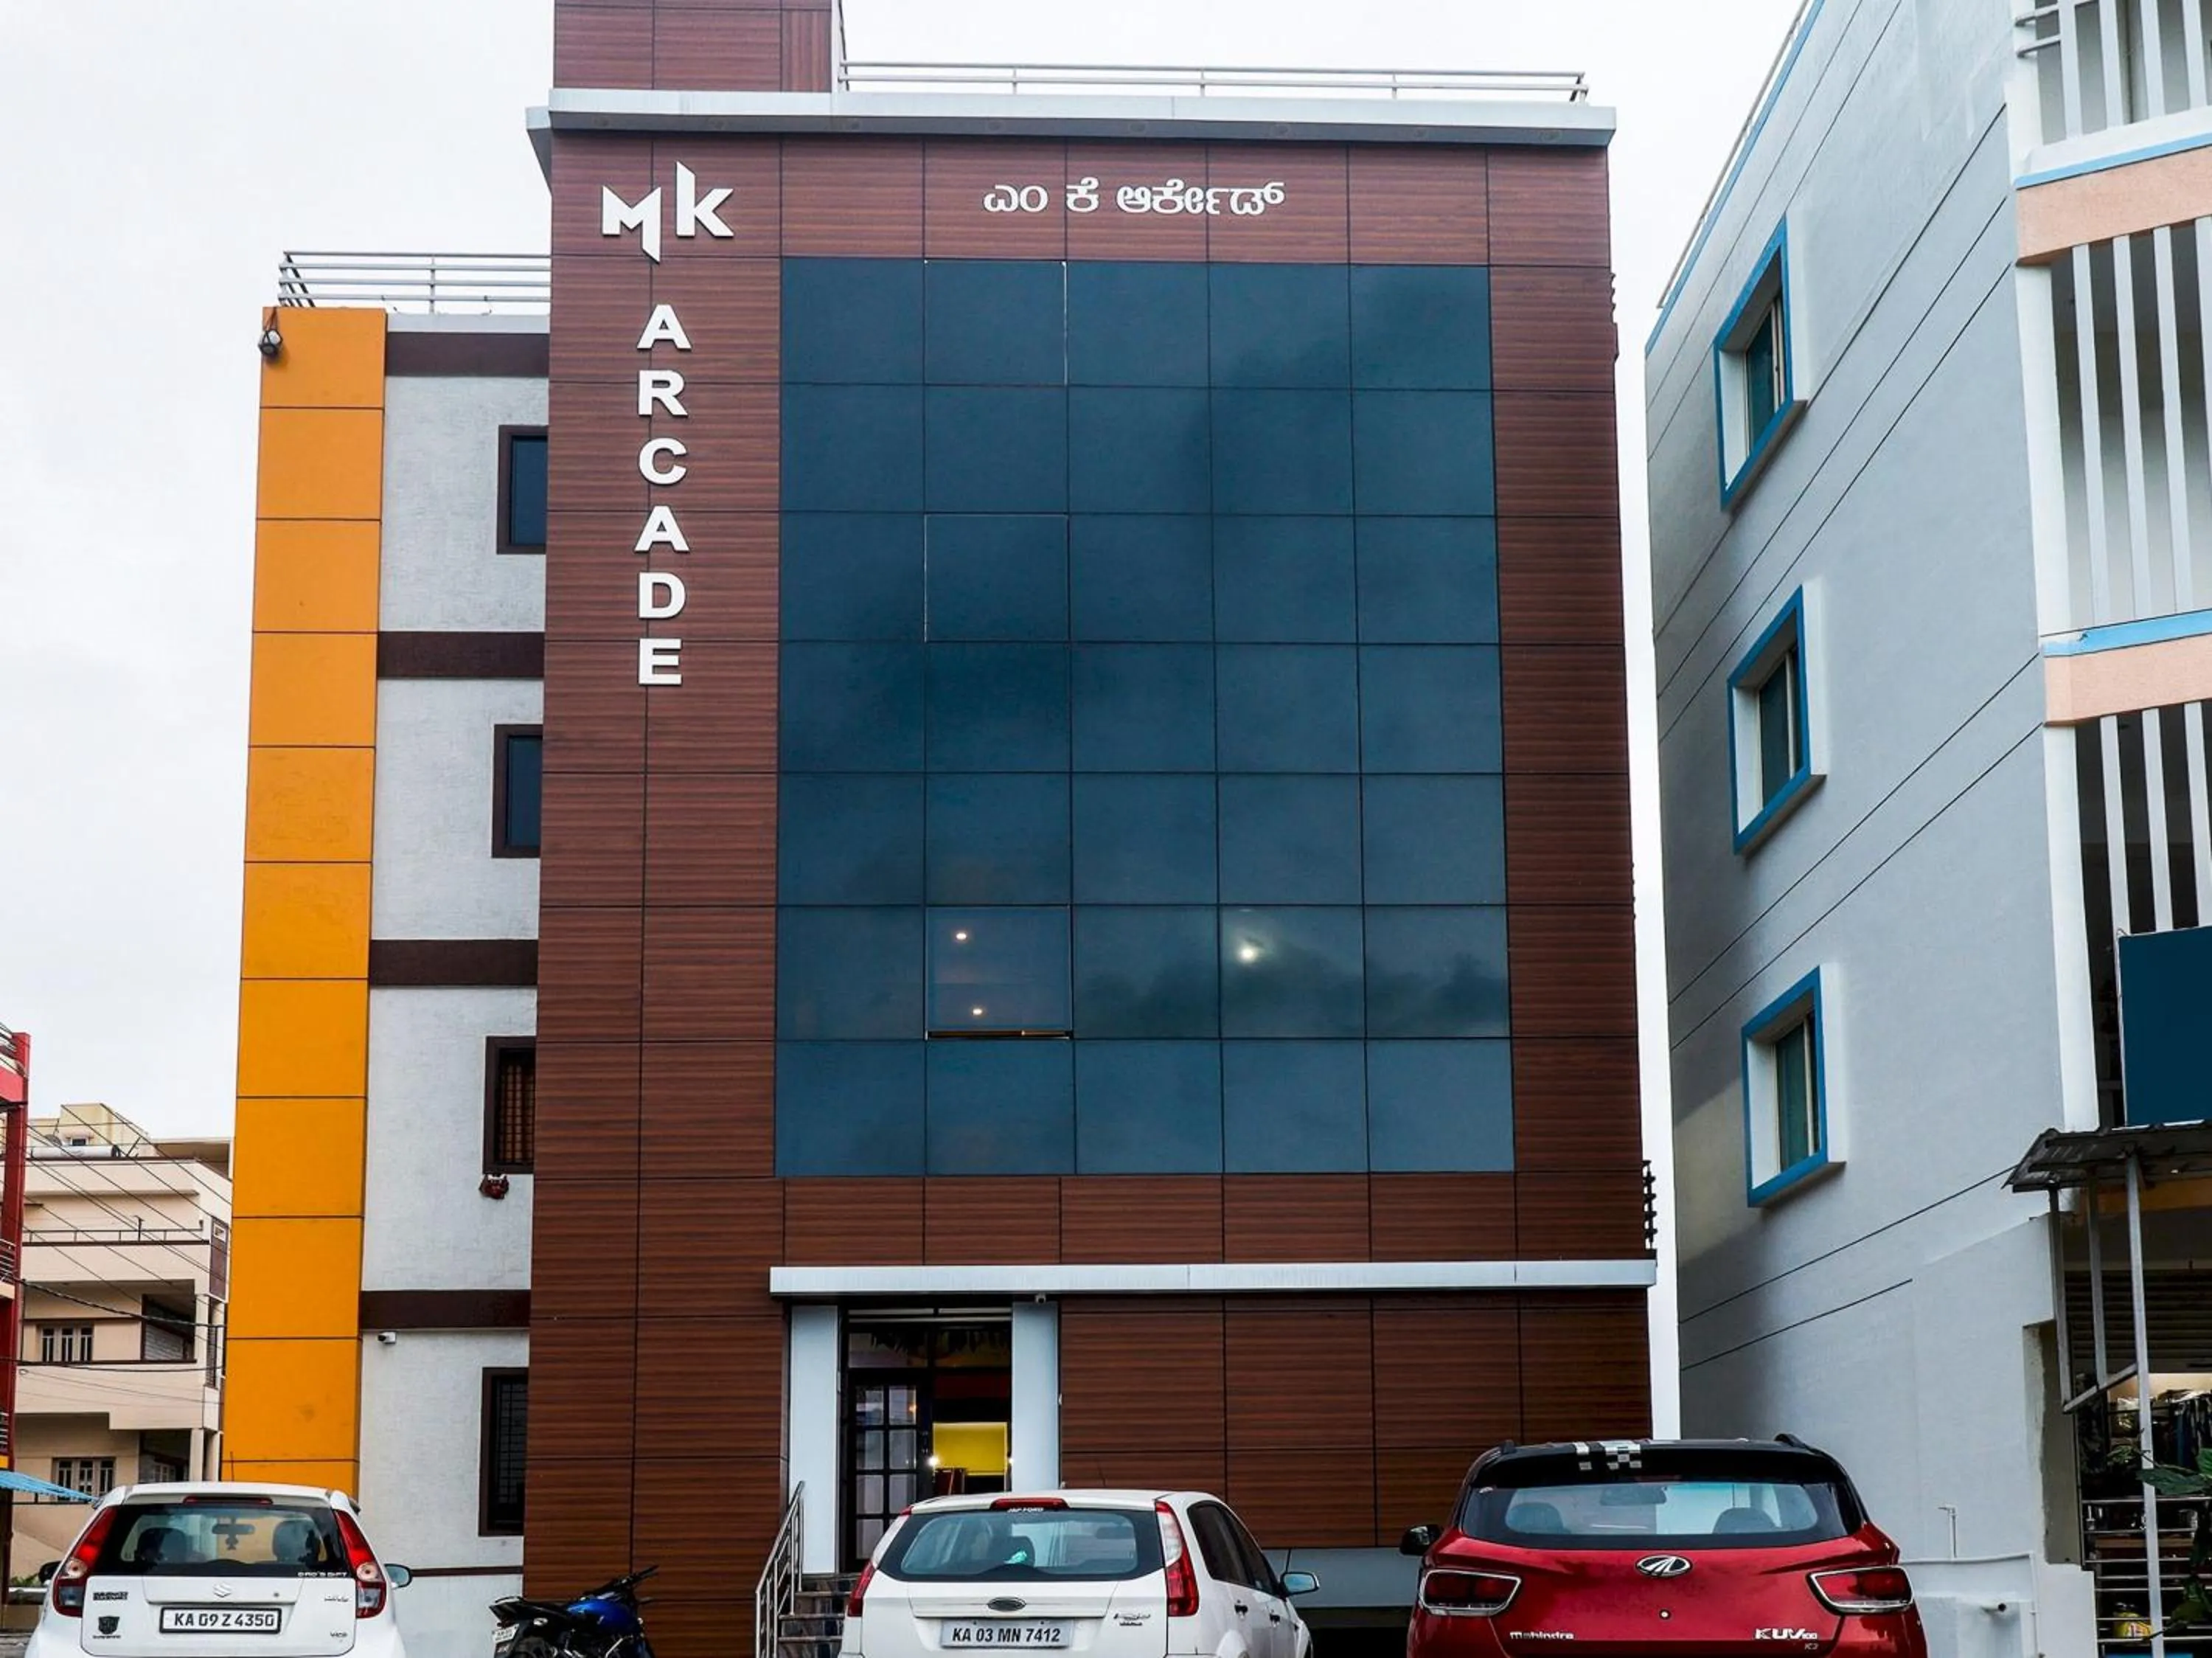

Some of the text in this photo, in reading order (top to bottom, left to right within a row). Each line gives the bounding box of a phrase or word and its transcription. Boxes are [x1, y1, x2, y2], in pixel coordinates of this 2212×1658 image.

[983, 184, 1048, 212] ಎಂ
[1065, 177, 1099, 213] ಕೆ
[634, 304, 692, 685] ARCADE
[174, 1613, 274, 1626] KA 09 Z 4350
[952, 1628, 1061, 1642] KA 03 MN 7412
